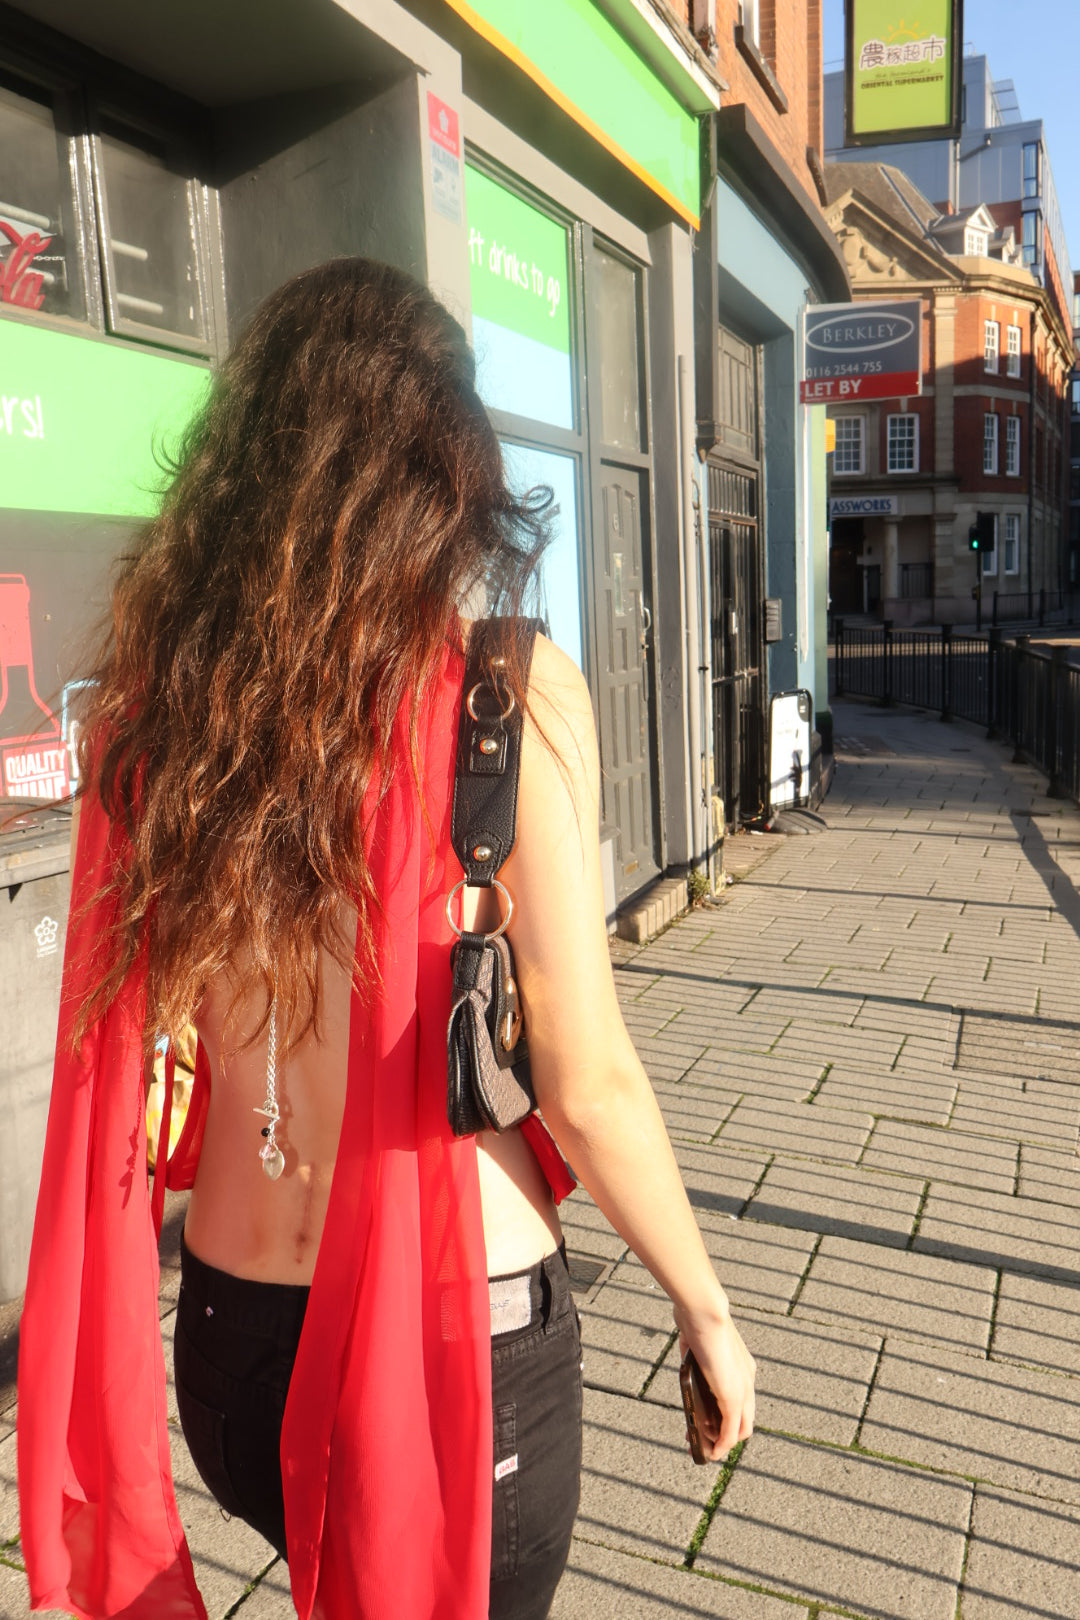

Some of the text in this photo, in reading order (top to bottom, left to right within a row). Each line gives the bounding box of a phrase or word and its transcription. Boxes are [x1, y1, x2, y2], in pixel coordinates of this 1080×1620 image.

[861, 75, 944, 90] ORIENTAL SUPERMARKET
[489, 239, 529, 289] drinks
[531, 261, 544, 297] to
[547, 276, 561, 318] go
[823, 323, 897, 344] BERKLEY
[806, 361, 883, 378] 0116 2544 755
[805, 379, 862, 398] LET BY
[6, 748, 66, 784] QUALITY
